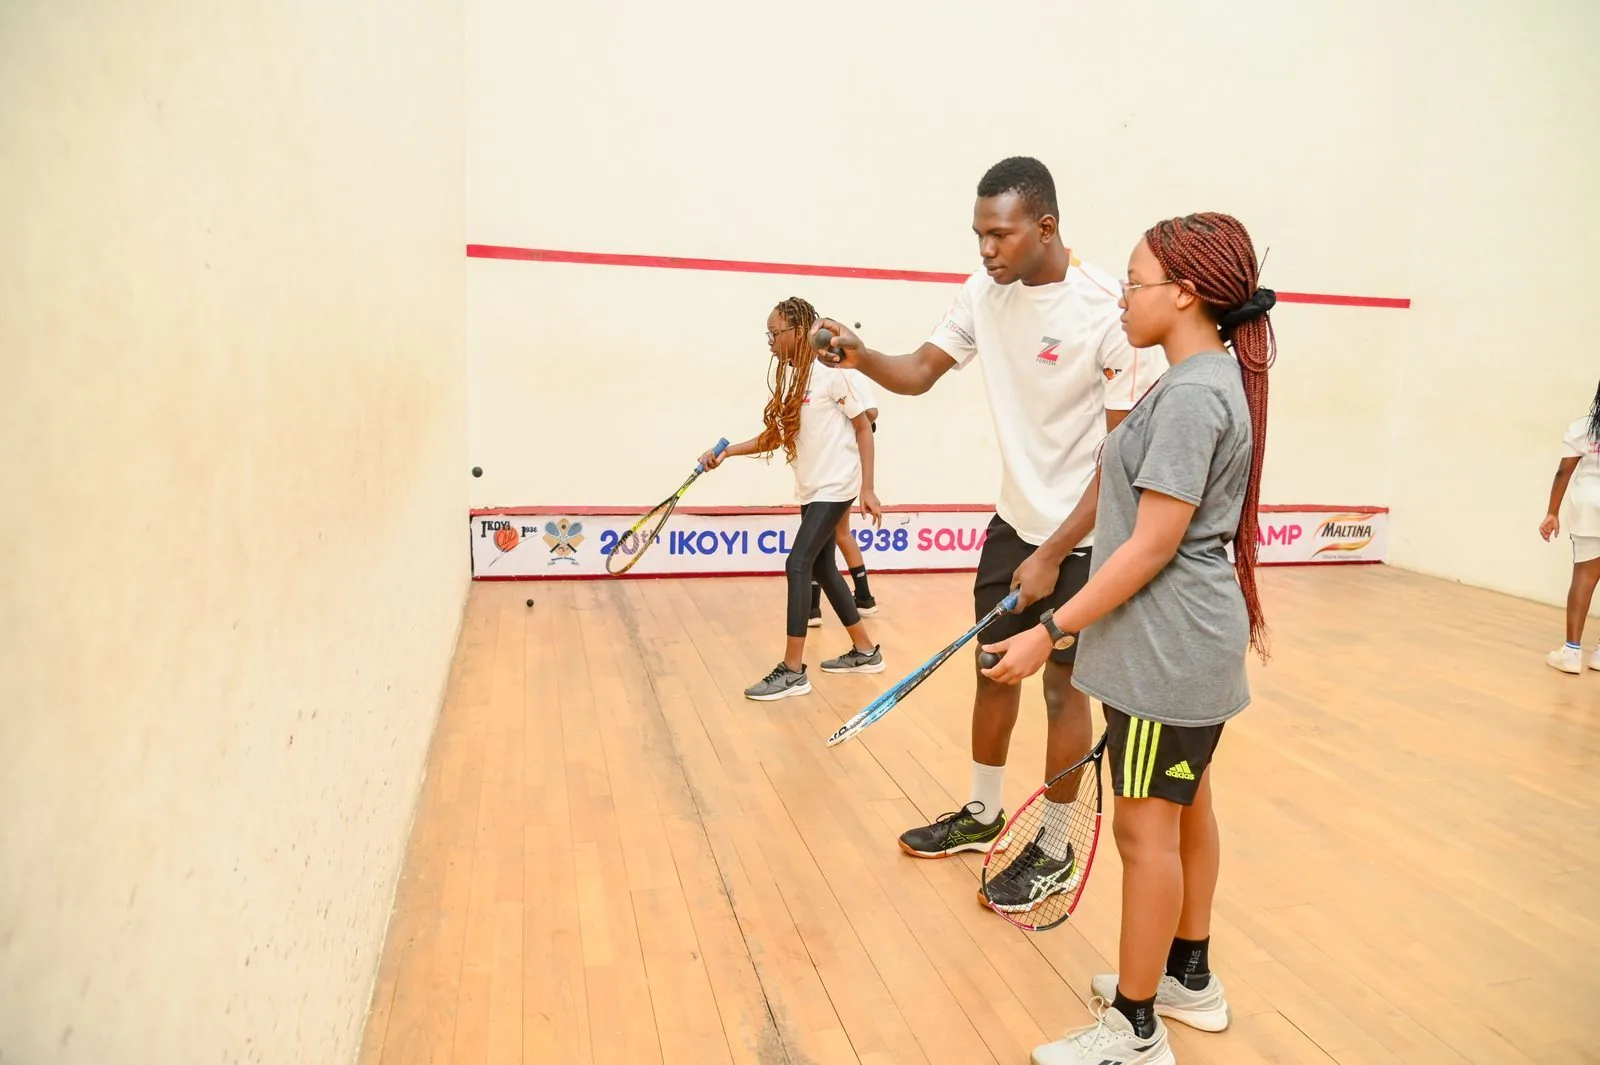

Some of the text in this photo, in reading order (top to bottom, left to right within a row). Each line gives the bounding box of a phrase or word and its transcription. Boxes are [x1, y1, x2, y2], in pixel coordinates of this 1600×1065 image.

[481, 520, 537, 538] IKOYI 1938
[669, 530, 749, 555] IKOYI
[1165, 769, 1195, 780] adidas
